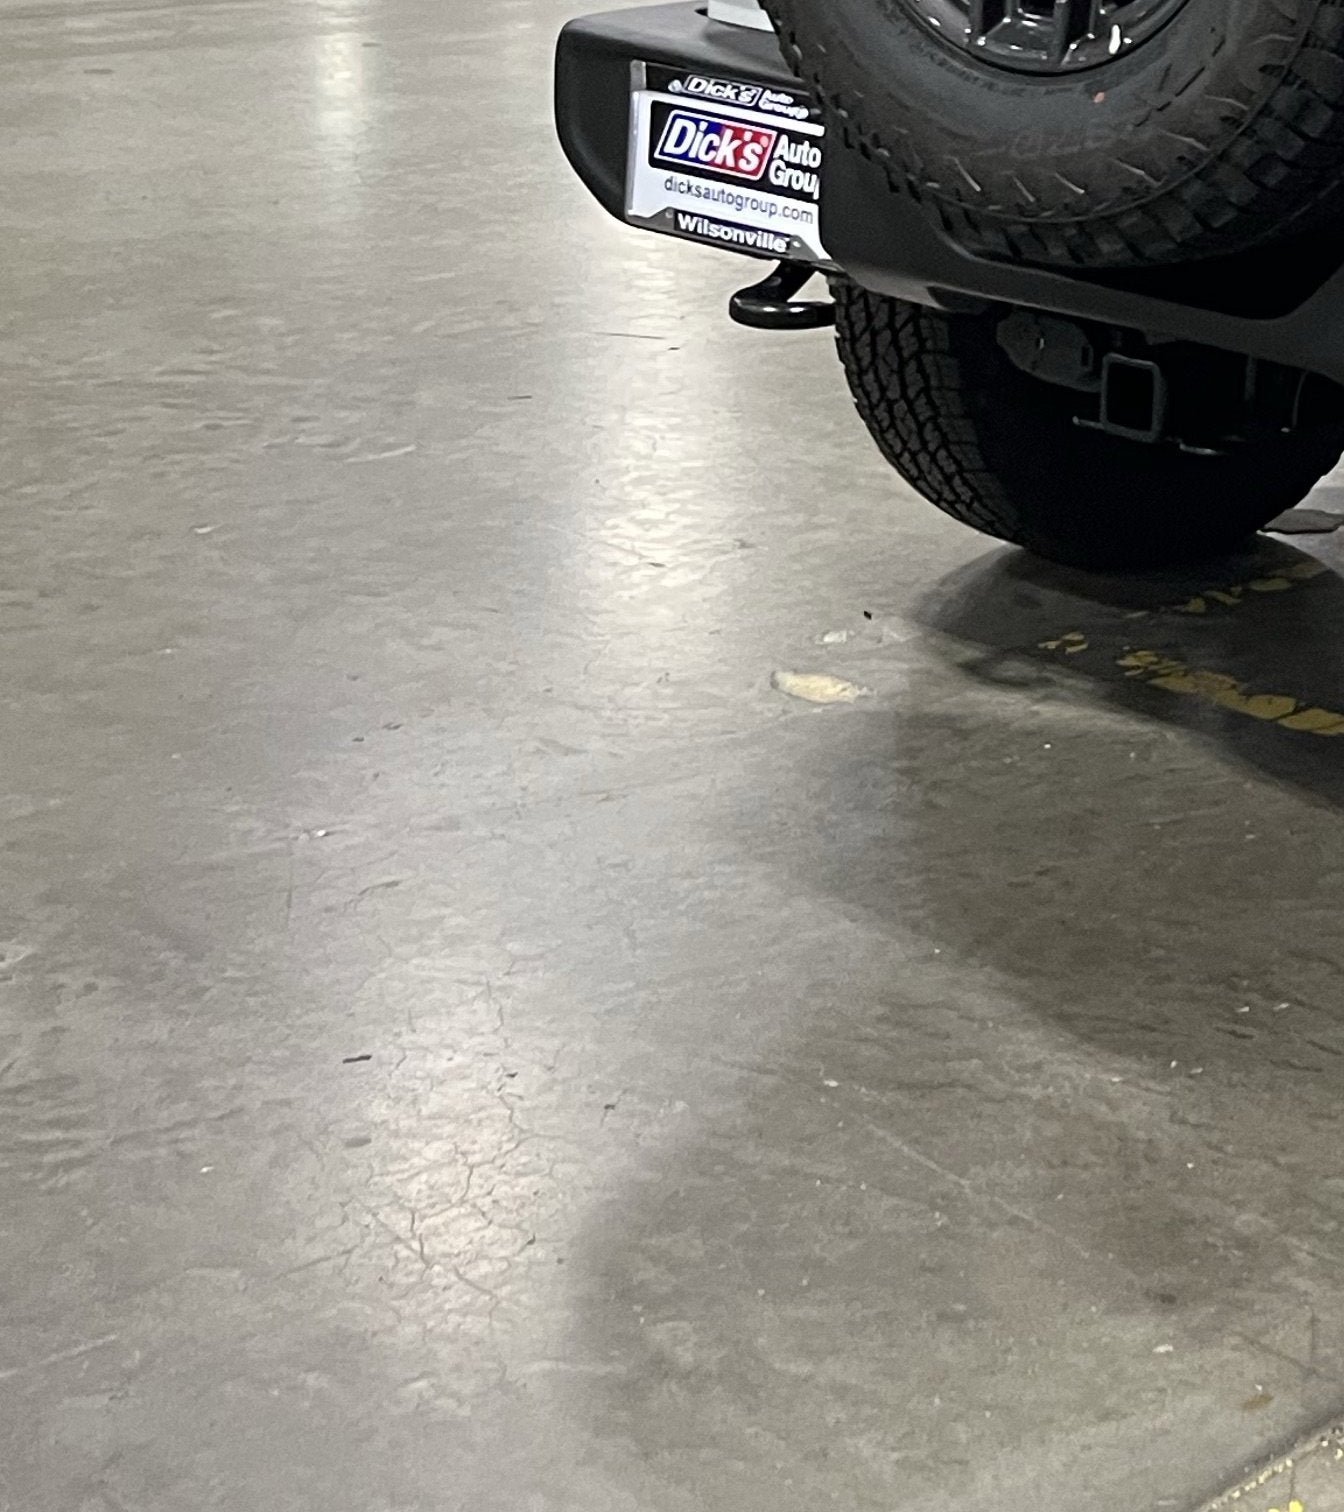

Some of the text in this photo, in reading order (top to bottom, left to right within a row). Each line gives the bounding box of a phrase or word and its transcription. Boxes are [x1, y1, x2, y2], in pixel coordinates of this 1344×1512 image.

[688, 77, 757, 103] Dick's
[663, 118, 769, 172] Dick's
[773, 134, 822, 168] Auto
[664, 176, 813, 224] dicksautogroup.com
[678, 212, 787, 252] Wilsonville
